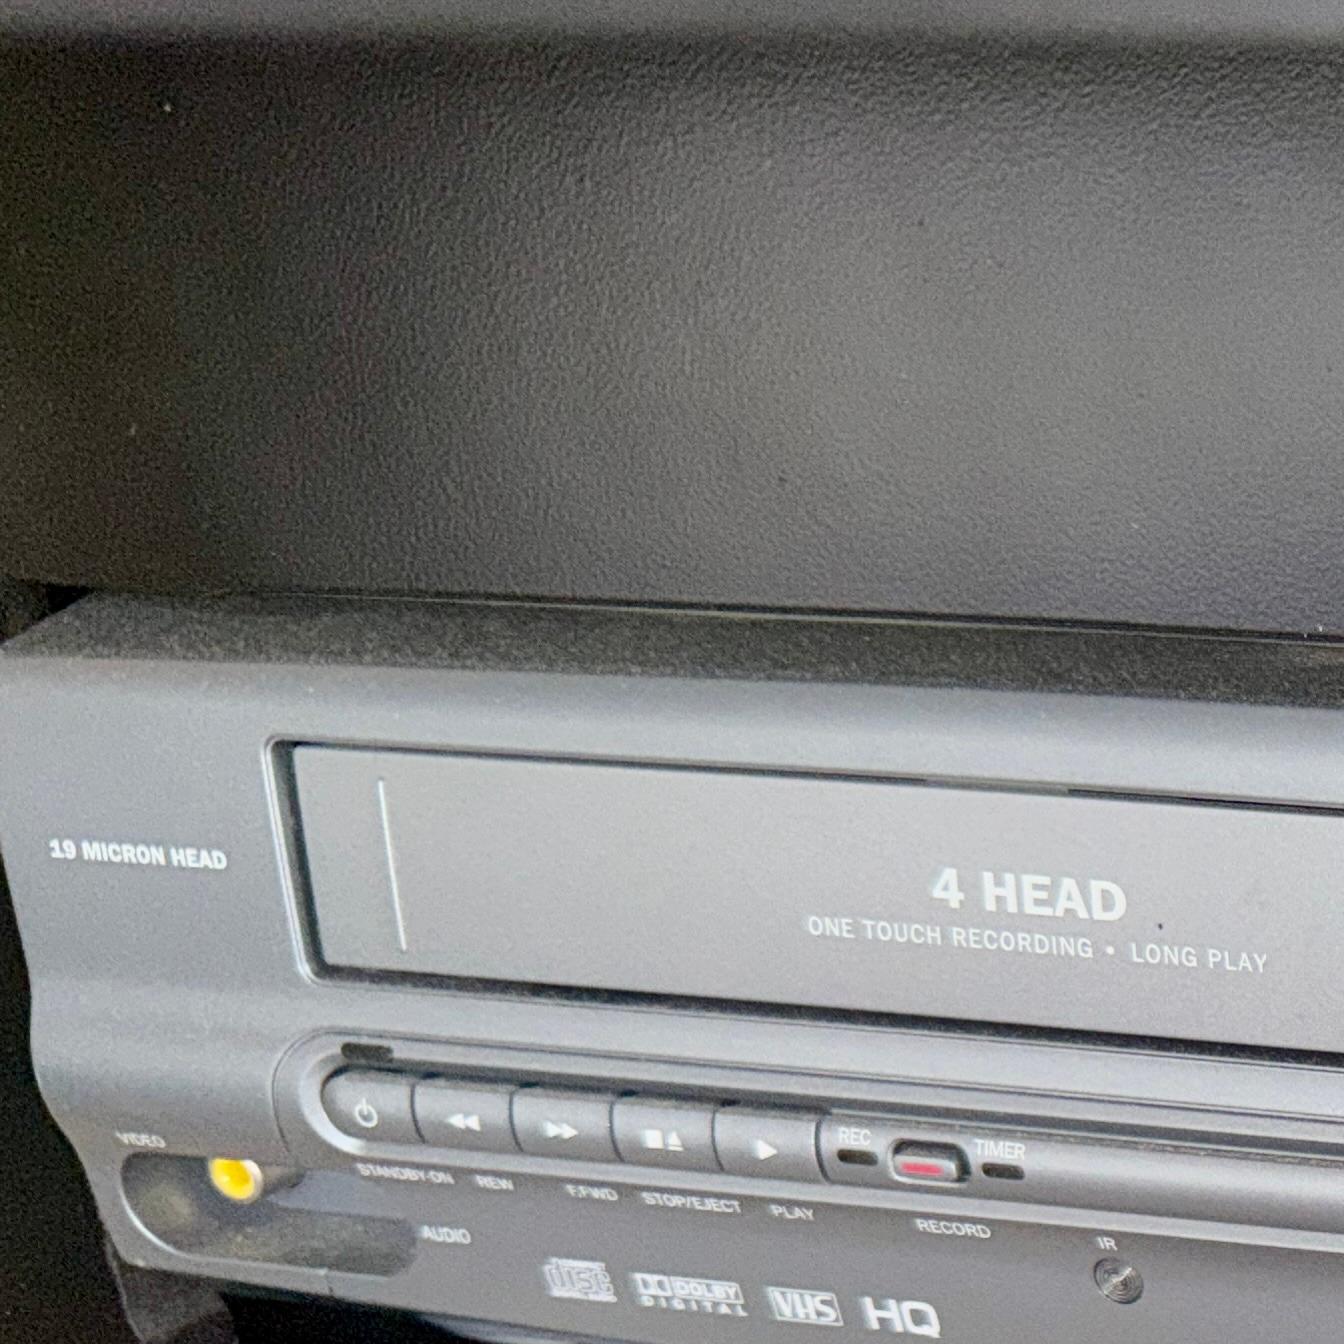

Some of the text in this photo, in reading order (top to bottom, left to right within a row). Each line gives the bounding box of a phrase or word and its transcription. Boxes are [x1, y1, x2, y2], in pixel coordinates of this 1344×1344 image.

[49, 837, 228, 870] 19 MICRON HEAD
[931, 866, 1128, 922] 4 HEAD
[807, 915, 1268, 974] ONE TOUCH RECORDING LONG PLAY
[115, 1130, 167, 1149] VIDEO
[837, 1126, 873, 1146] REC
[974, 1137, 1027, 1160] TIMER
[475, 1174, 515, 1192] REW
[641, 1191, 742, 1214] STOP/EJECT
[769, 1203, 816, 1222] PLAY
[418, 1223, 472, 1245] AUDIO
[915, 1217, 992, 1240] RECORD
[1097, 1236, 1119, 1252] IR
[675, 1277, 739, 1300] DOLBY
[639, 1295, 748, 1318] DIGITAL
[772, 1288, 838, 1323] VHS
[861, 1296, 942, 1338] HQ
